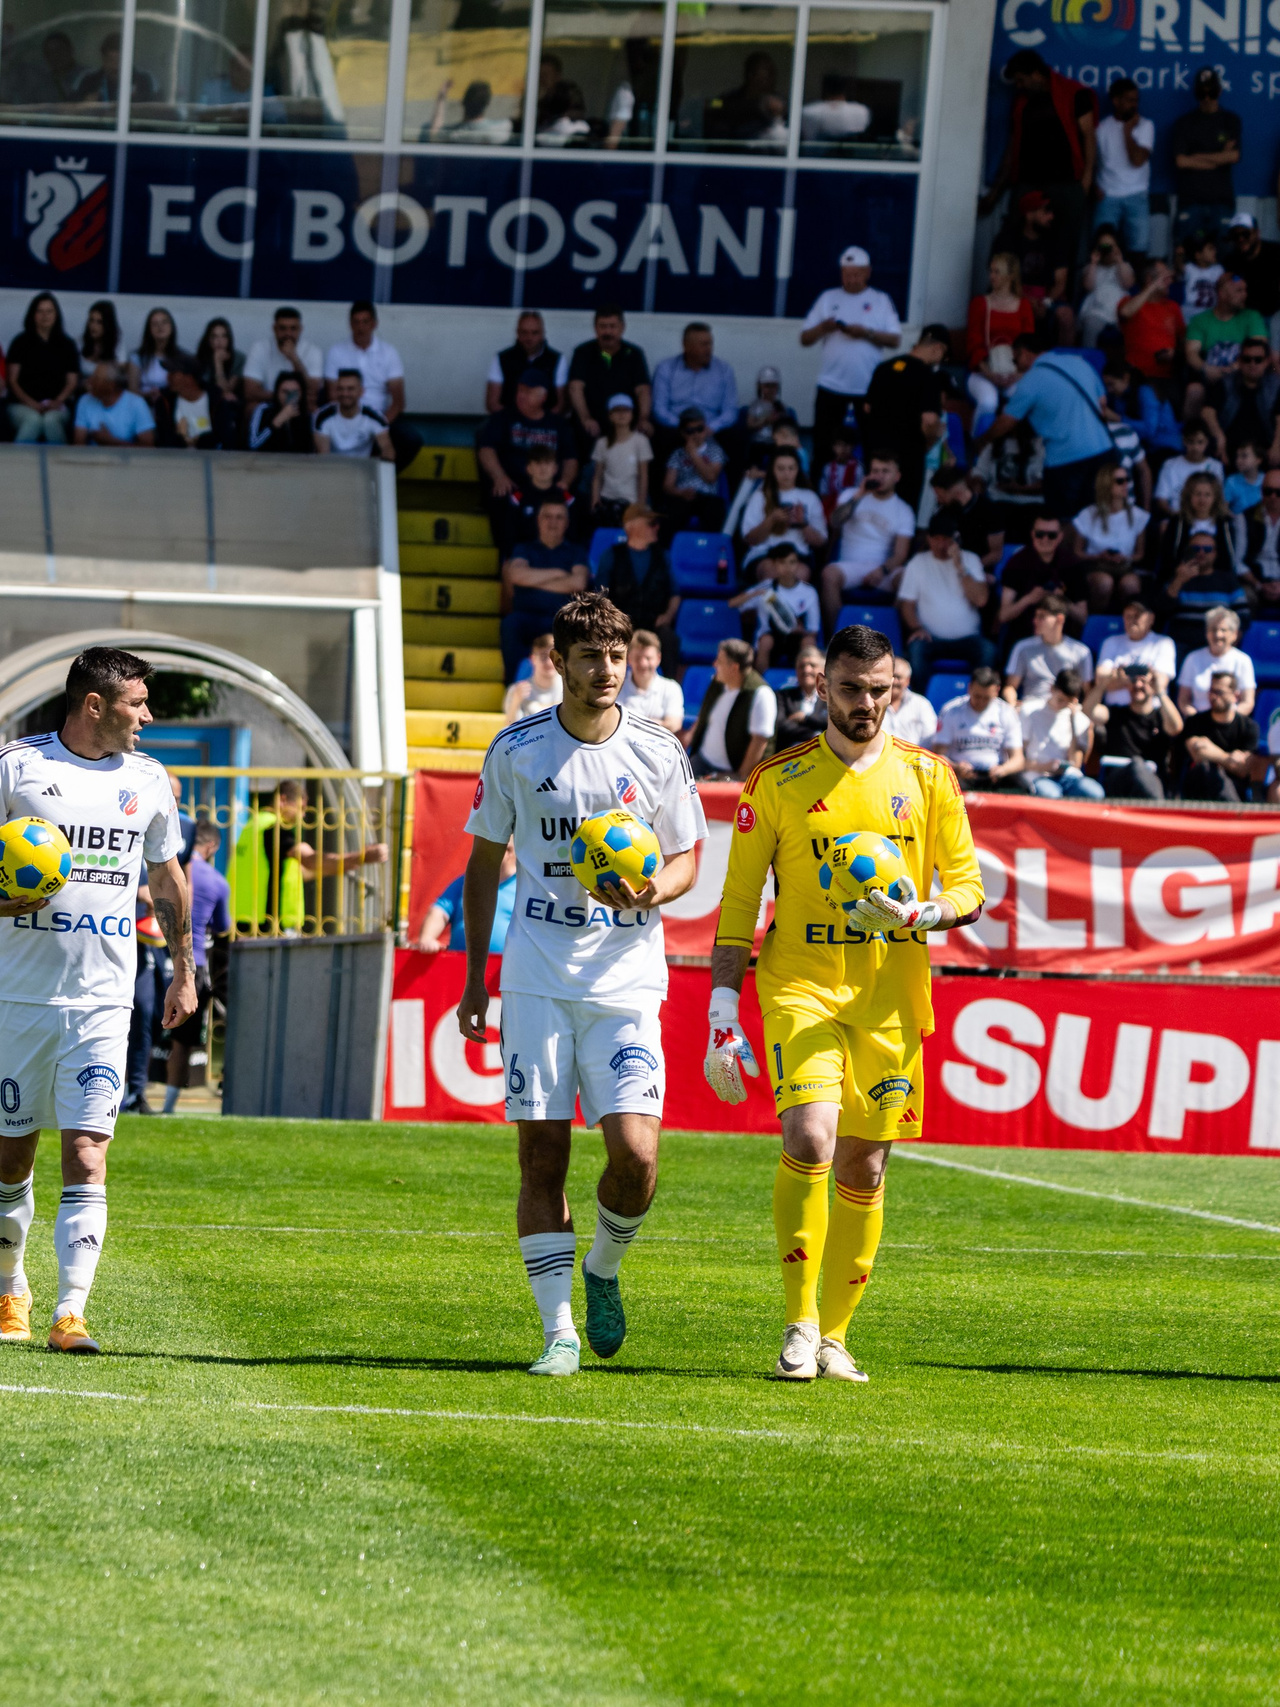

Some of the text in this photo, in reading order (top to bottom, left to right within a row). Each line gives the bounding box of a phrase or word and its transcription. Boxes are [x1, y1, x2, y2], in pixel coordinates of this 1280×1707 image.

[147, 185, 797, 290] FC BOTOȘANI
[436, 585, 451, 609] 5
[440, 652, 455, 676] 4
[445, 721, 460, 743] 3
[776, 764, 816, 787] ELECTROALFA
[58, 824, 140, 853] NIBET
[590, 852, 610, 870] 12
[833, 847, 848, 862] 12
[45, 876, 62, 893] 12
[89, 871, 112, 884] SPRE
[112, 873, 125, 885] 0%
[525, 897, 650, 928] ELSACO
[13, 911, 131, 938] ELSACO
[611, 1055, 622, 1069] FIVE
[773, 1042, 784, 1081] 1
[79, 1071, 90, 1084] FIVE
[508, 1053, 526, 1094] 6
[790, 1083, 824, 1092] Vestra
[871, 1085, 884, 1098] FIVE
[5, 1116, 33, 1126] Vestra
